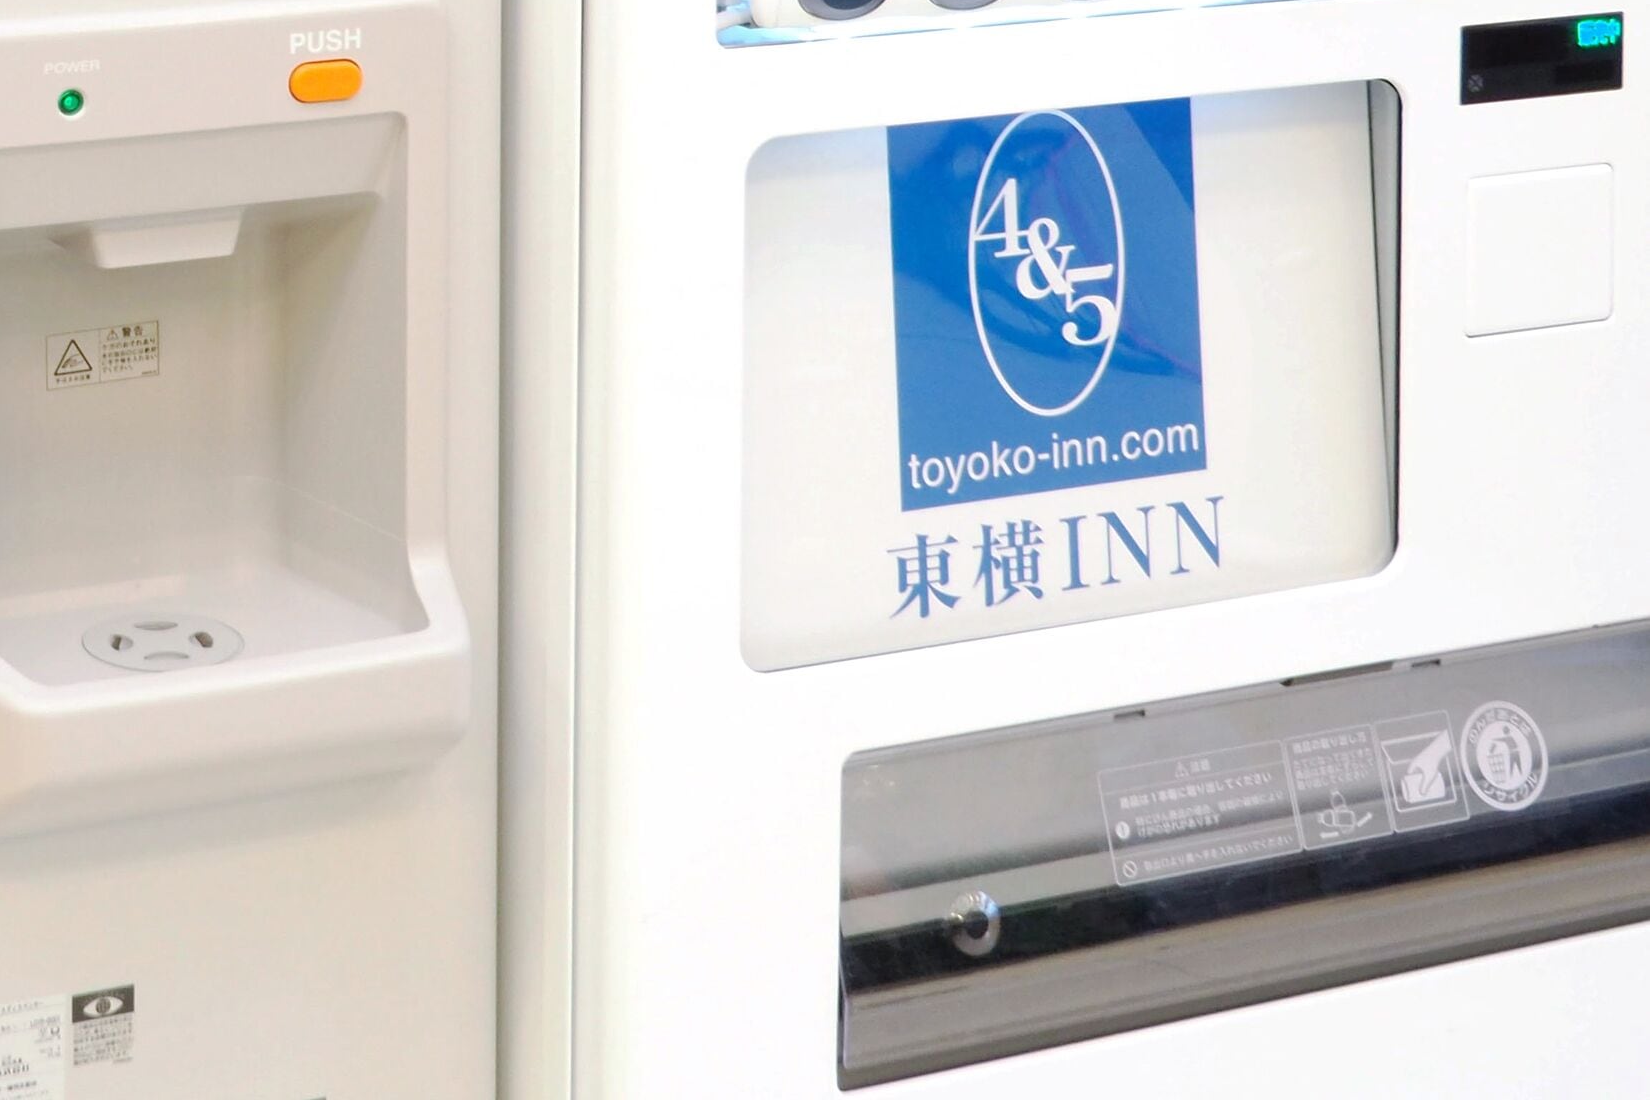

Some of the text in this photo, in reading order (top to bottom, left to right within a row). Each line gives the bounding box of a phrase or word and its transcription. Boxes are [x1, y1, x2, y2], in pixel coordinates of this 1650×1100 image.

[289, 27, 362, 55] PUSH
[44, 58, 101, 76] POWER
[908, 422, 1200, 494] toyoko-inn.com
[886, 495, 1225, 620] 東横INN
